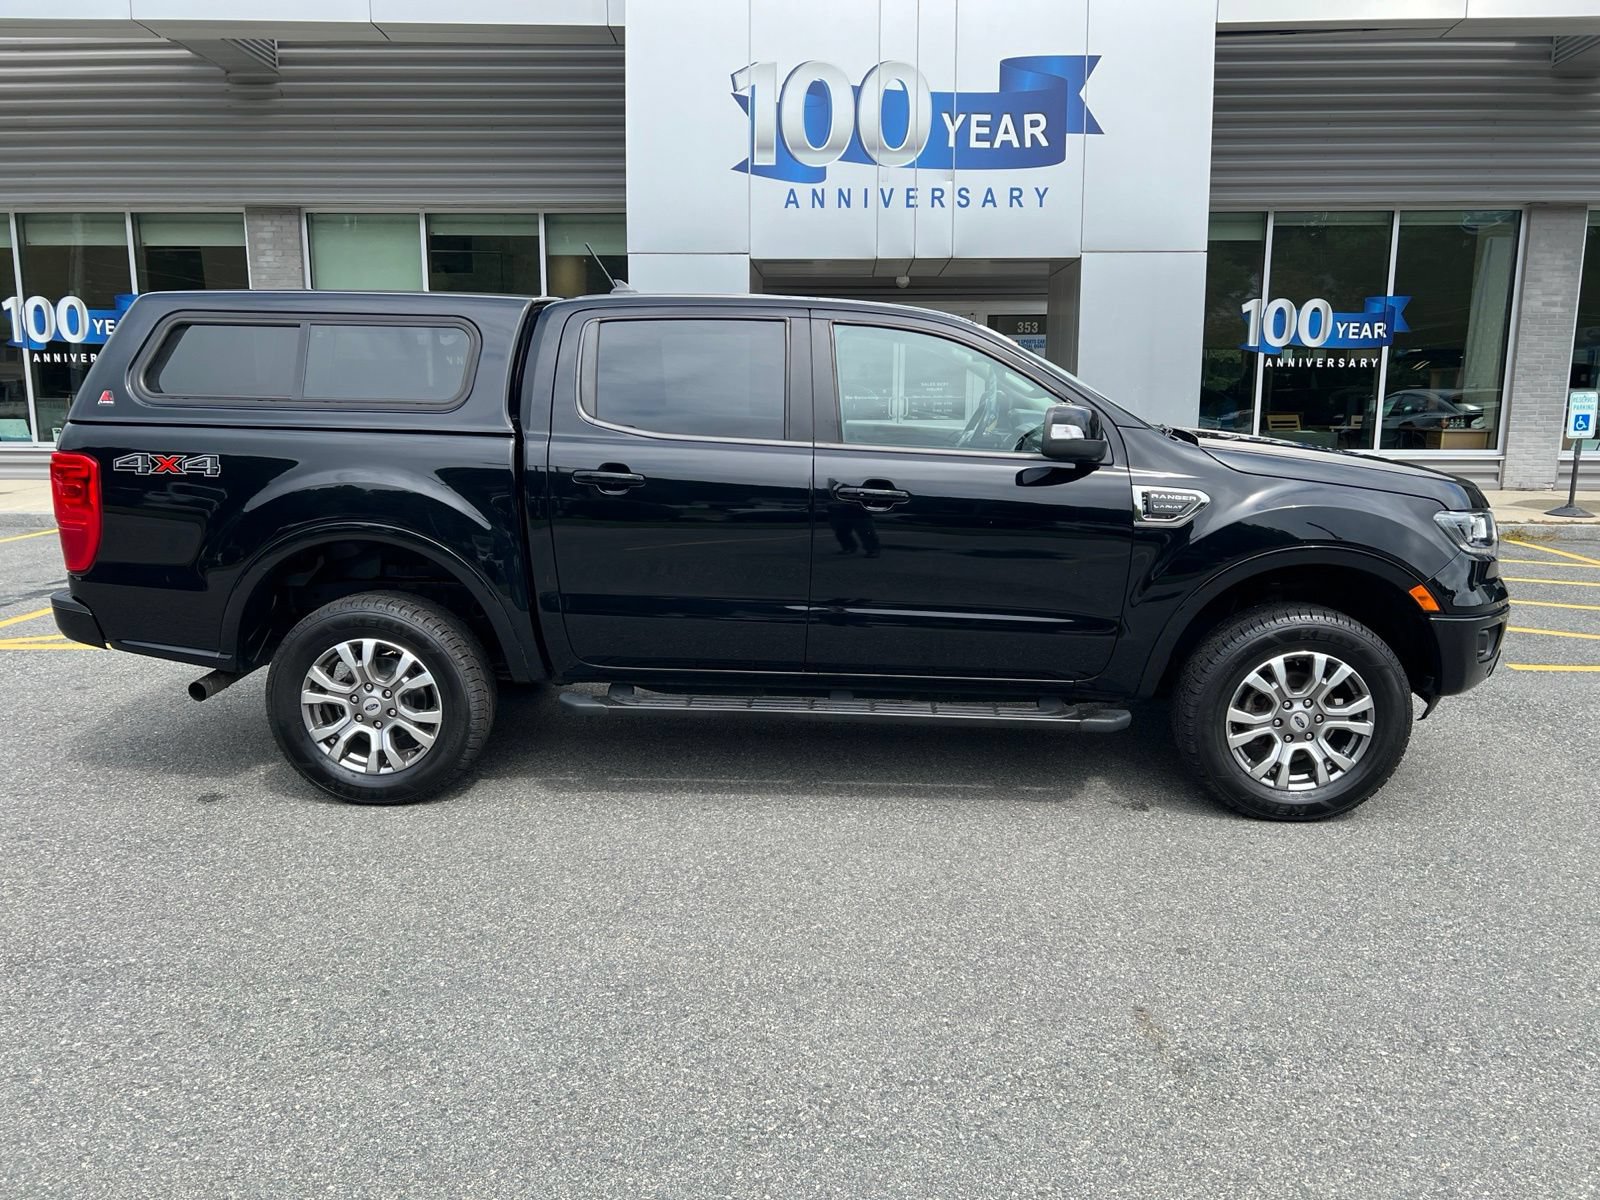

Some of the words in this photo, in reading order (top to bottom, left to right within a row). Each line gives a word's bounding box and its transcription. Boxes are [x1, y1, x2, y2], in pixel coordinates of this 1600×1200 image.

[731, 60, 932, 167] 100
[941, 112, 1049, 149] YEAR
[784, 186, 1050, 209] ANNIVERSARY
[2, 295, 89, 343] 100
[92, 319, 122, 335] YE
[1017, 321, 1039, 333] 353
[1241, 298, 1333, 347] 100
[1336, 322, 1387, 339] YEAR
[1265, 358, 1379, 368] ANNIVERSARY
[1151, 493, 1197, 501] RANGER
